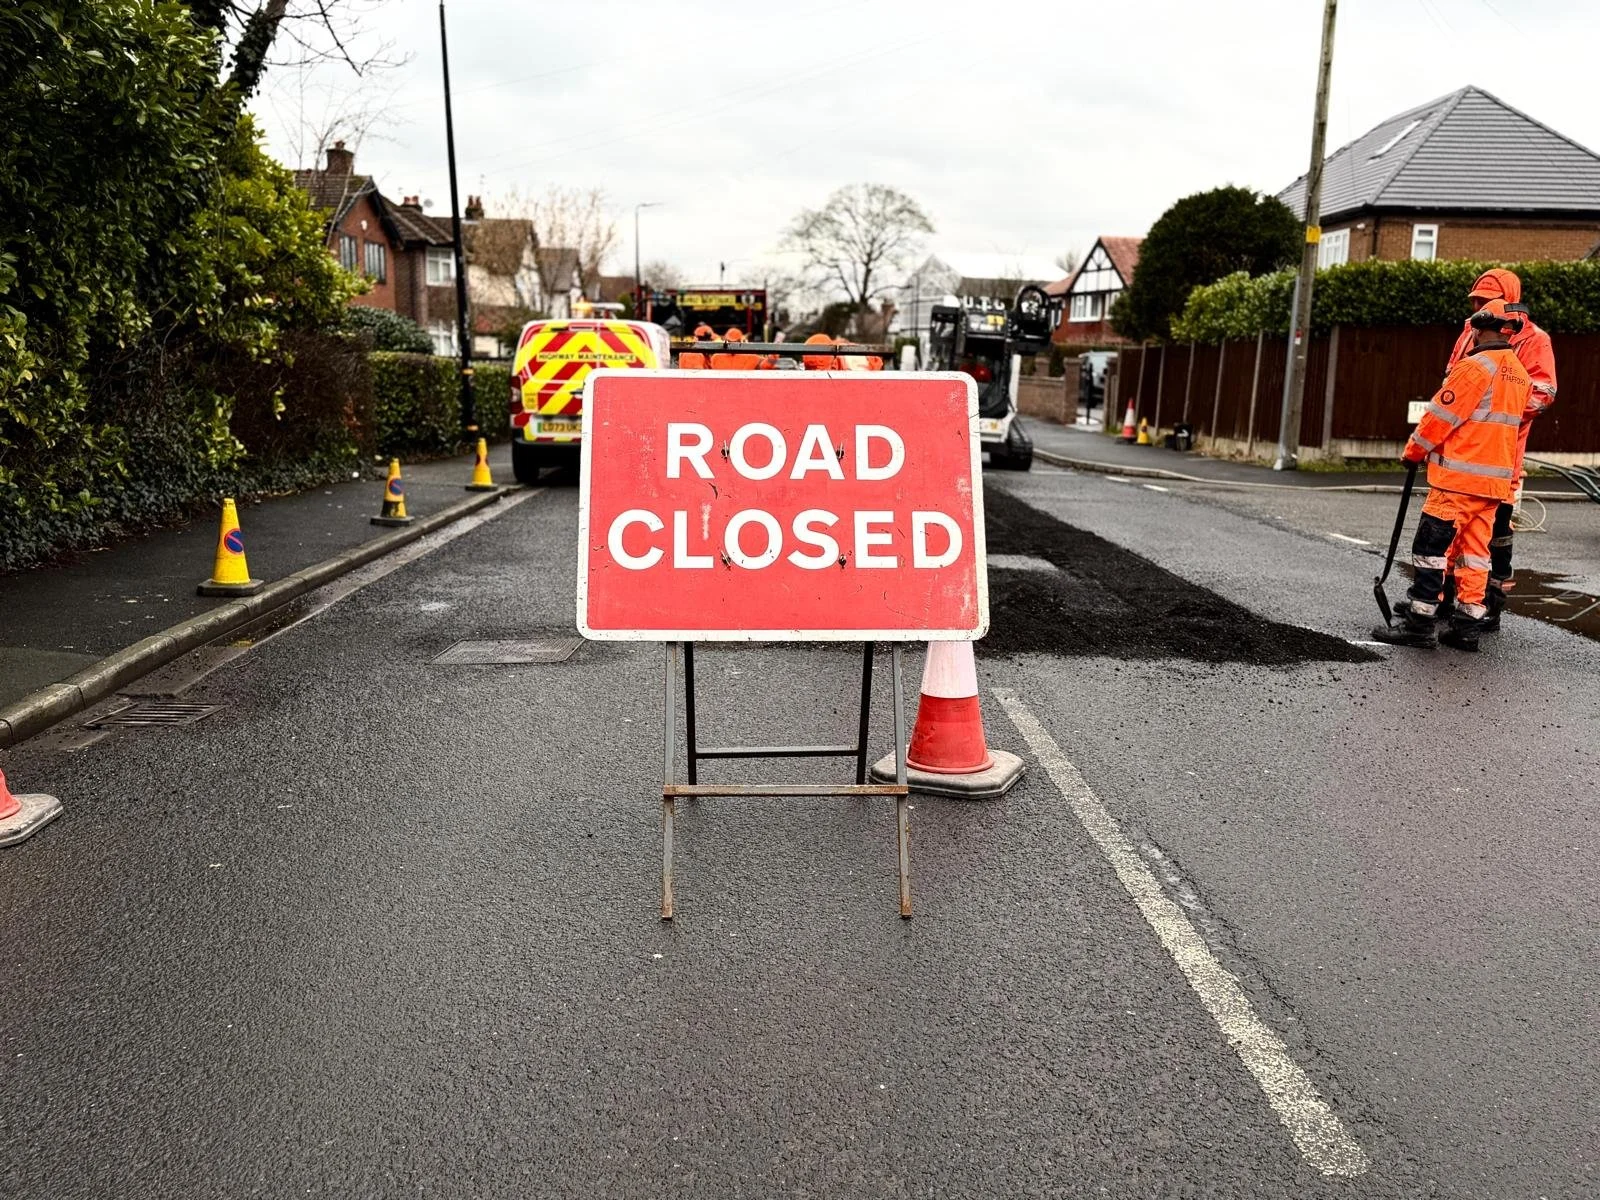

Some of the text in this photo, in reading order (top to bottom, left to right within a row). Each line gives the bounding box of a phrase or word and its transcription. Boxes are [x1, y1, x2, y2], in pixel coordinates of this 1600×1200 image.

[538, 353, 634, 362] HIGHWAY MAINTENANCE
[666, 421, 906, 481] ROAD
[606, 508, 964, 571] CLOSED
